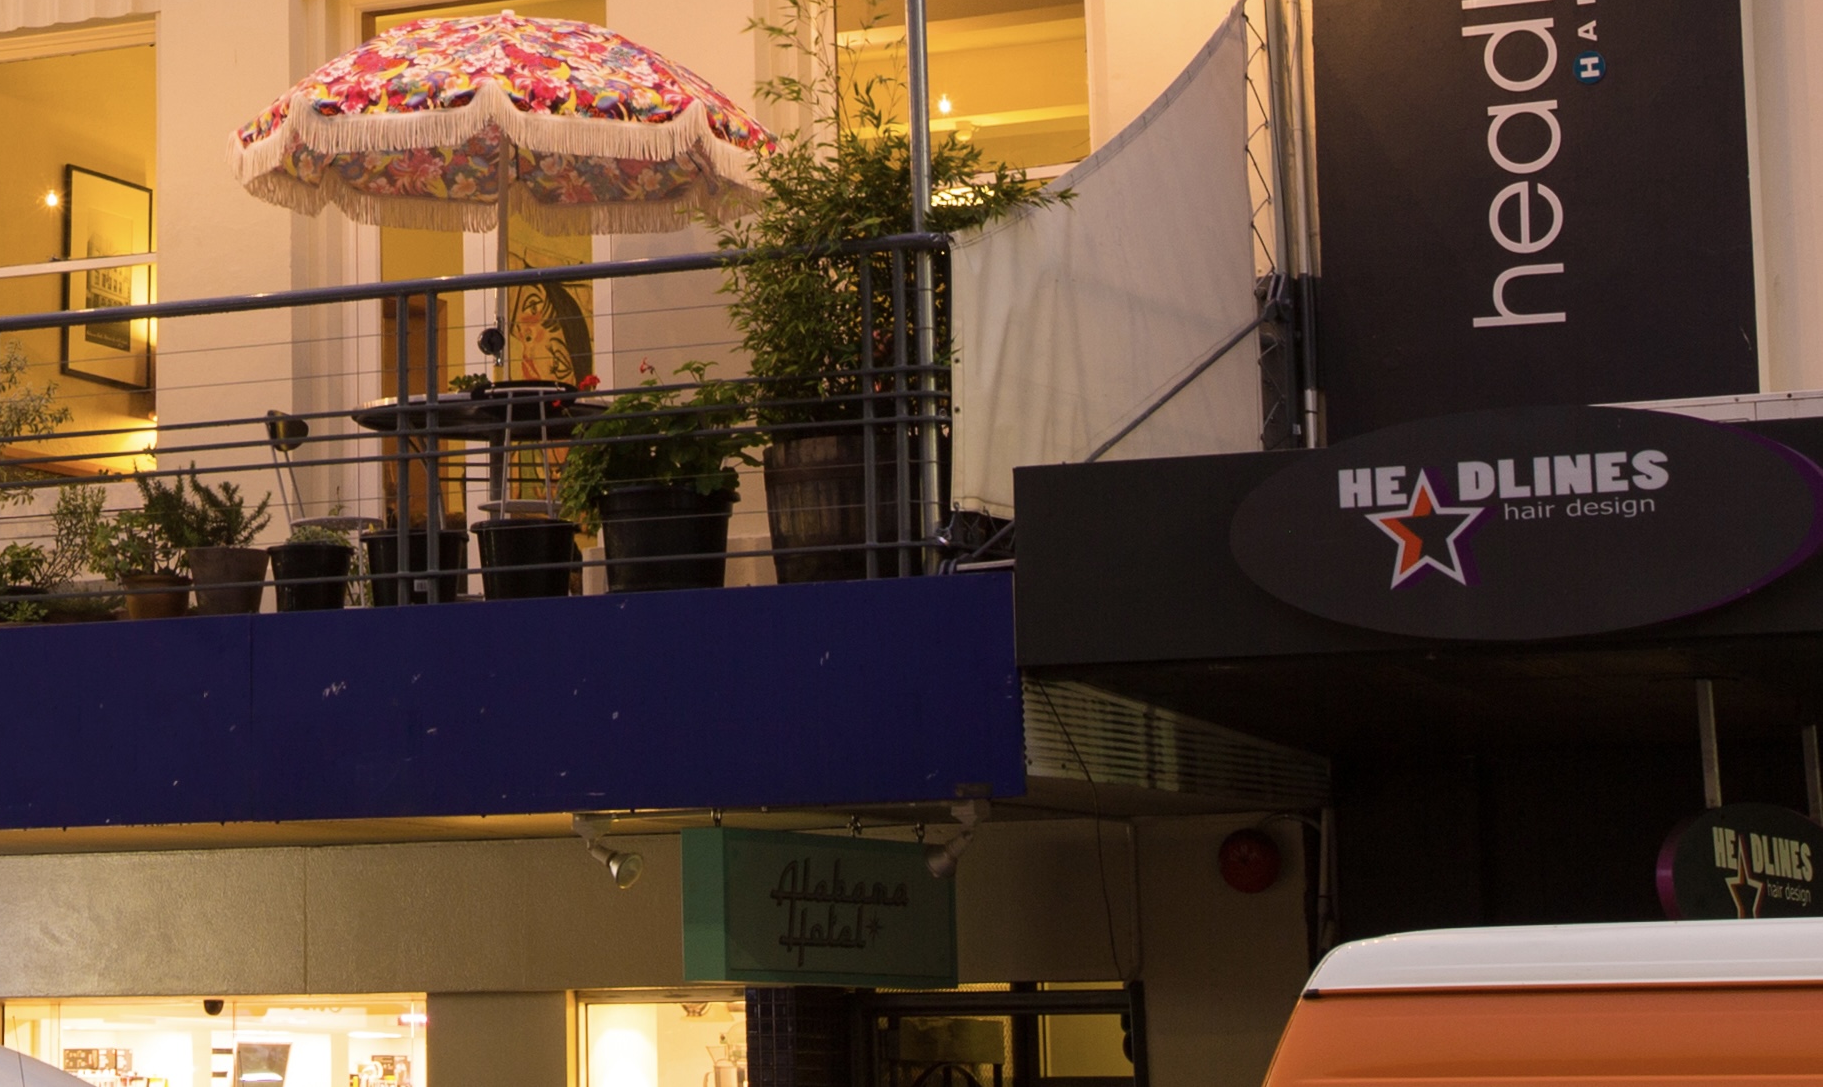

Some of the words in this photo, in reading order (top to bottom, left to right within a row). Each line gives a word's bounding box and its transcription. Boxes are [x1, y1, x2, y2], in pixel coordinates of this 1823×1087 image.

[1503, 501, 1556, 521] hair
[1565, 496, 1656, 518] design
[1766, 879, 1784, 899] hair
[1784, 882, 1812, 907] design
[778, 903, 867, 968] Hotel
